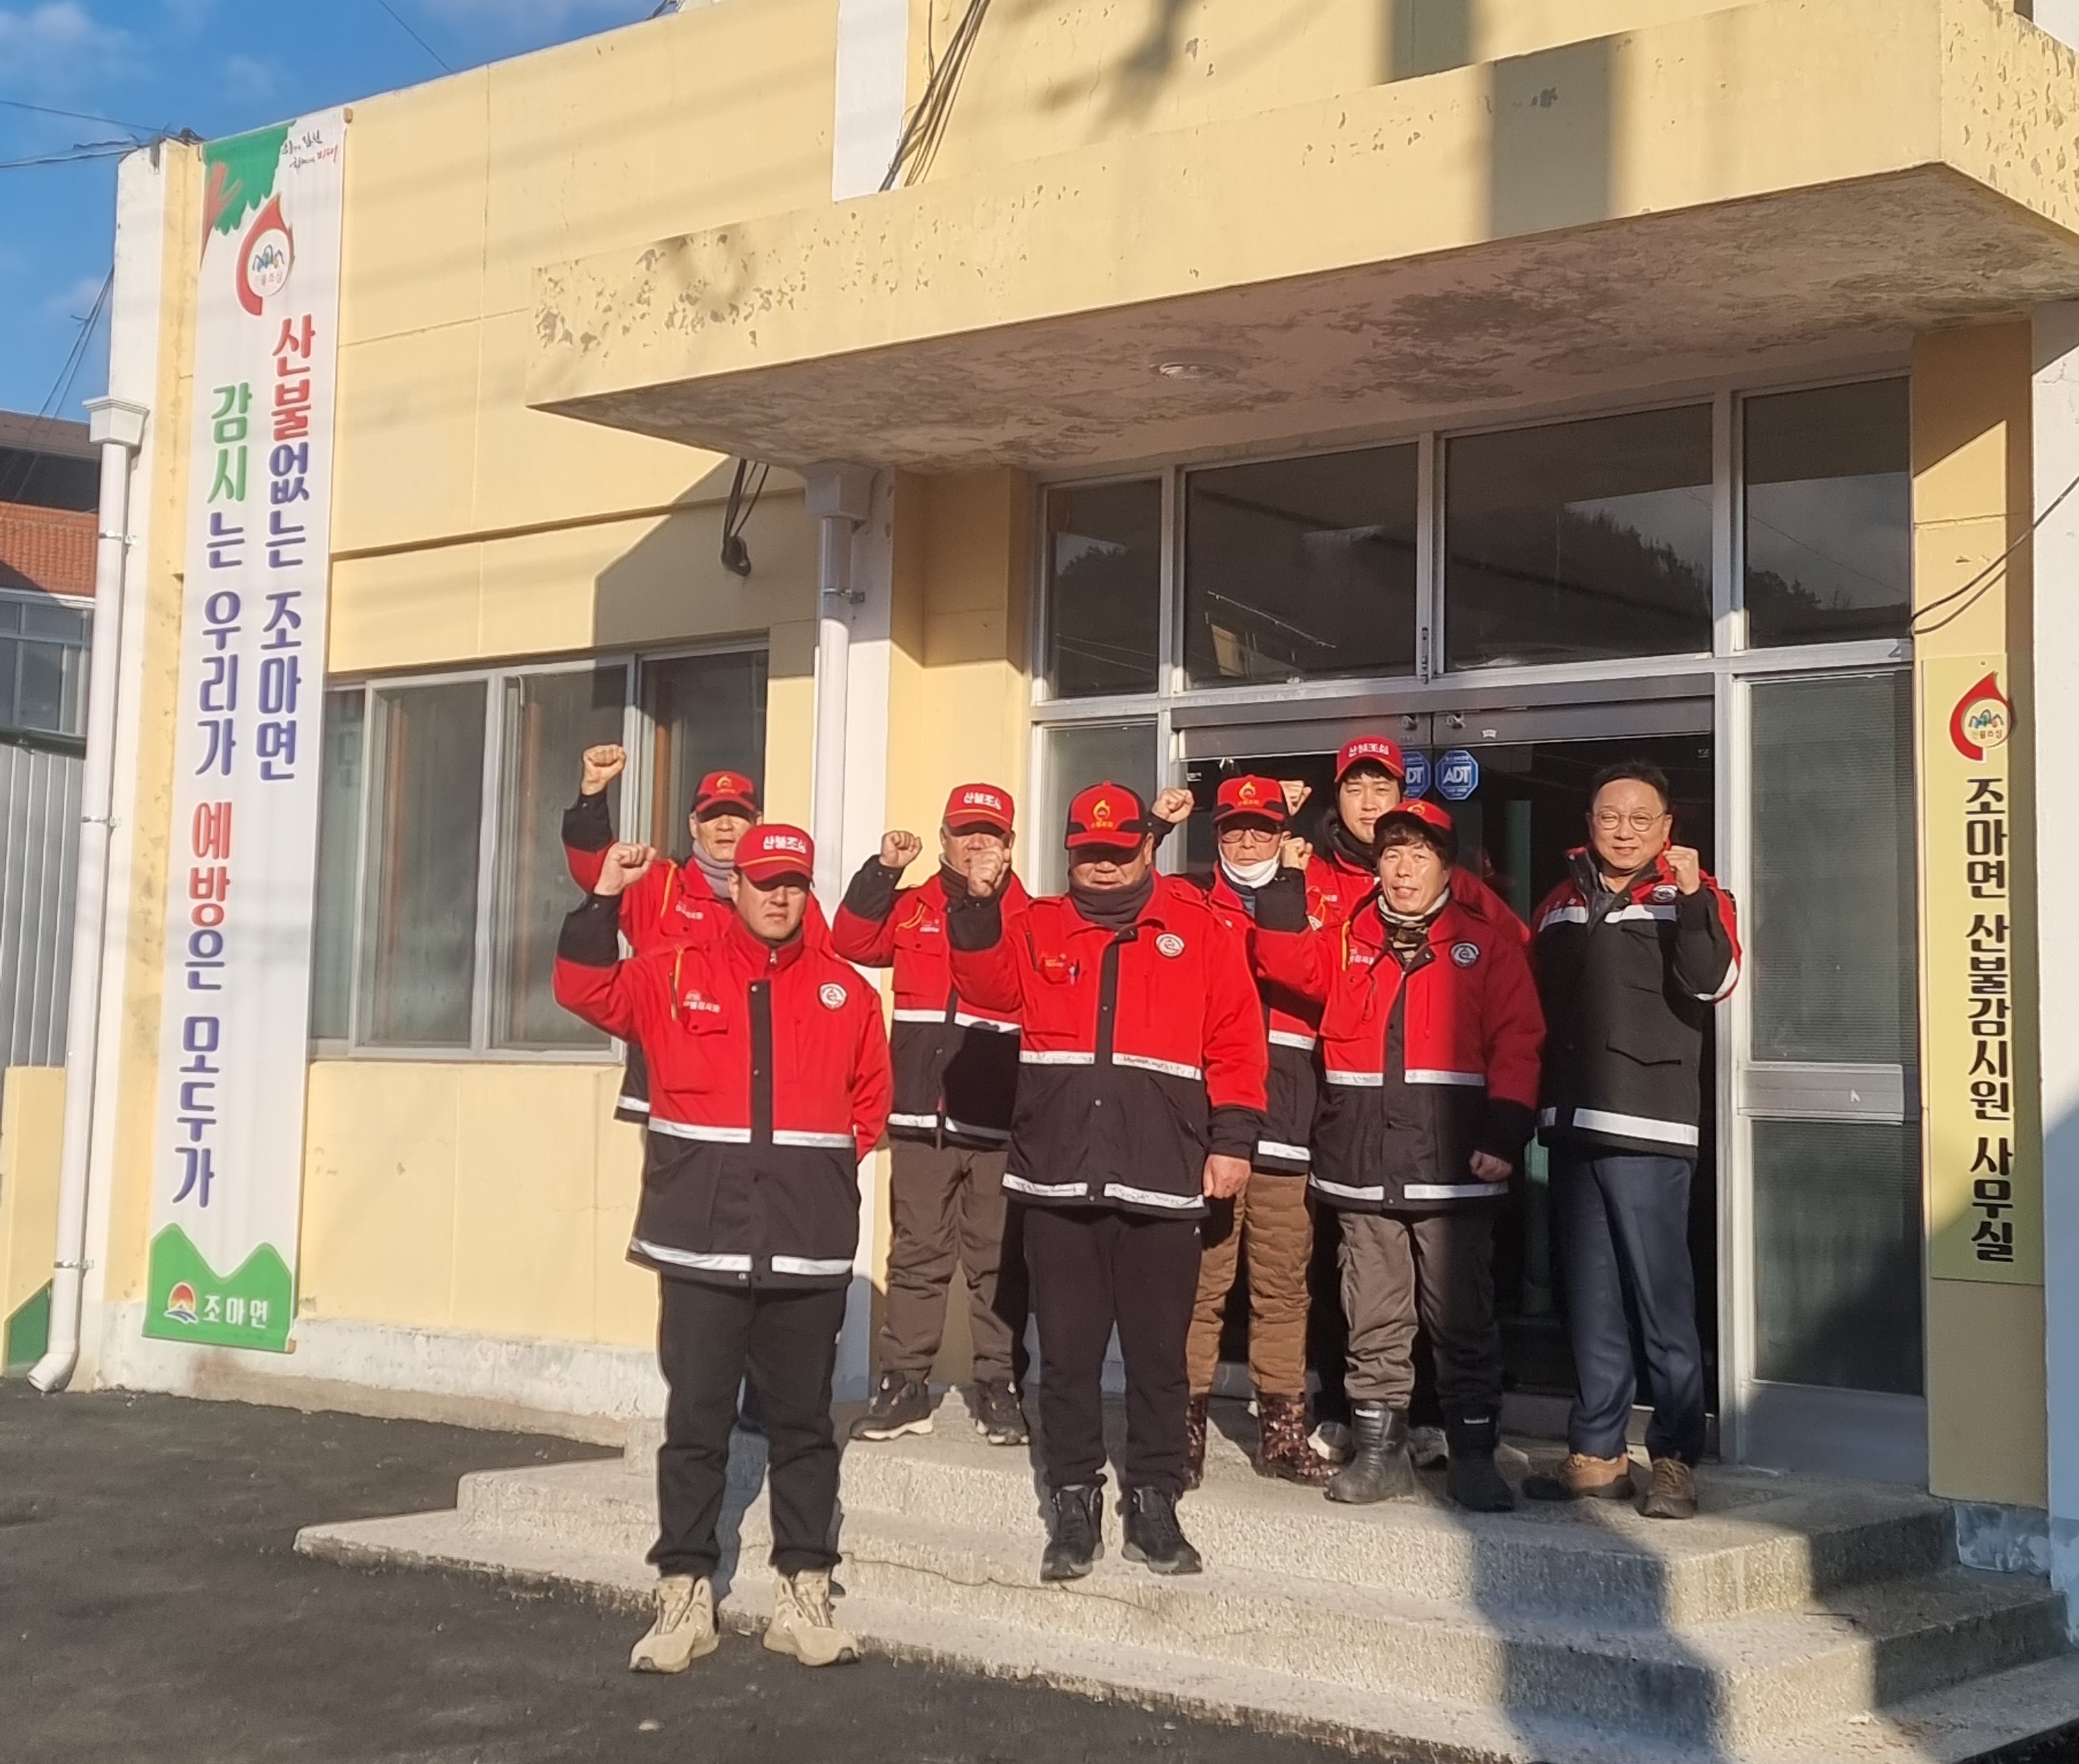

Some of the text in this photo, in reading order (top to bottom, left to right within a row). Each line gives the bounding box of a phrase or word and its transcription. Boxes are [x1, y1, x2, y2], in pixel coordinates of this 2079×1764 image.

[255, 313, 316, 781] 산불없는 조마면
[1405, 766, 1425, 784] DT
[1441, 766, 1471, 784] ADT
[171, 382, 253, 1208] 감시는 우리가 예방은 모두가
[763, 835, 807, 854] 산불조심
[1965, 778, 2014, 1263] 조마면 산불감시원 사무실
[202, 1295, 268, 1330] 조마면
